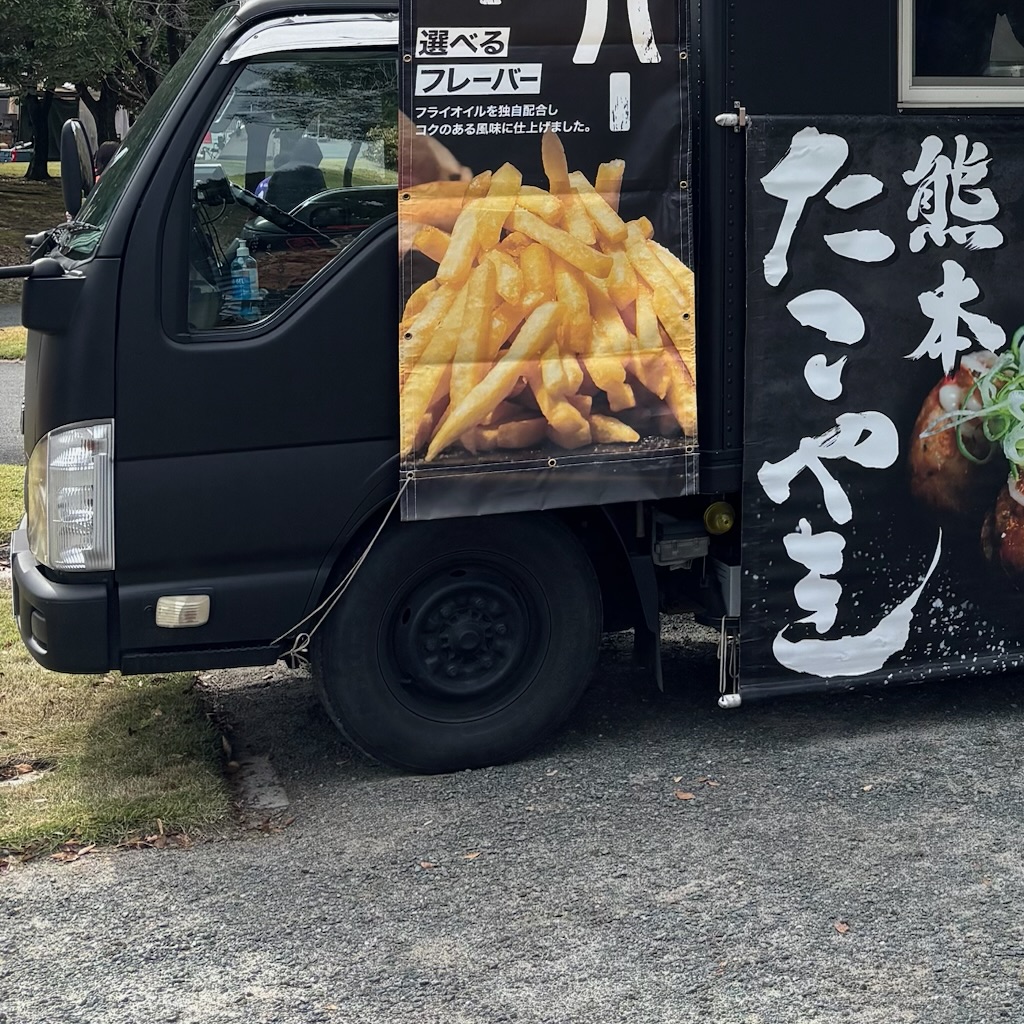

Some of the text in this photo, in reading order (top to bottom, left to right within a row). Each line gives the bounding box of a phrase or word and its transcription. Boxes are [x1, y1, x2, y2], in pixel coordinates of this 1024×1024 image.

[418, 29, 506, 56] 選べる
[421, 67, 539, 93] フレーバー
[415, 104, 558, 119] フライオイルを独自配合し
[415, 120, 591, 136] コクのある風味に仕上げました。
[902, 134, 1006, 376] 熊本
[757, 126, 943, 678] たこやき
